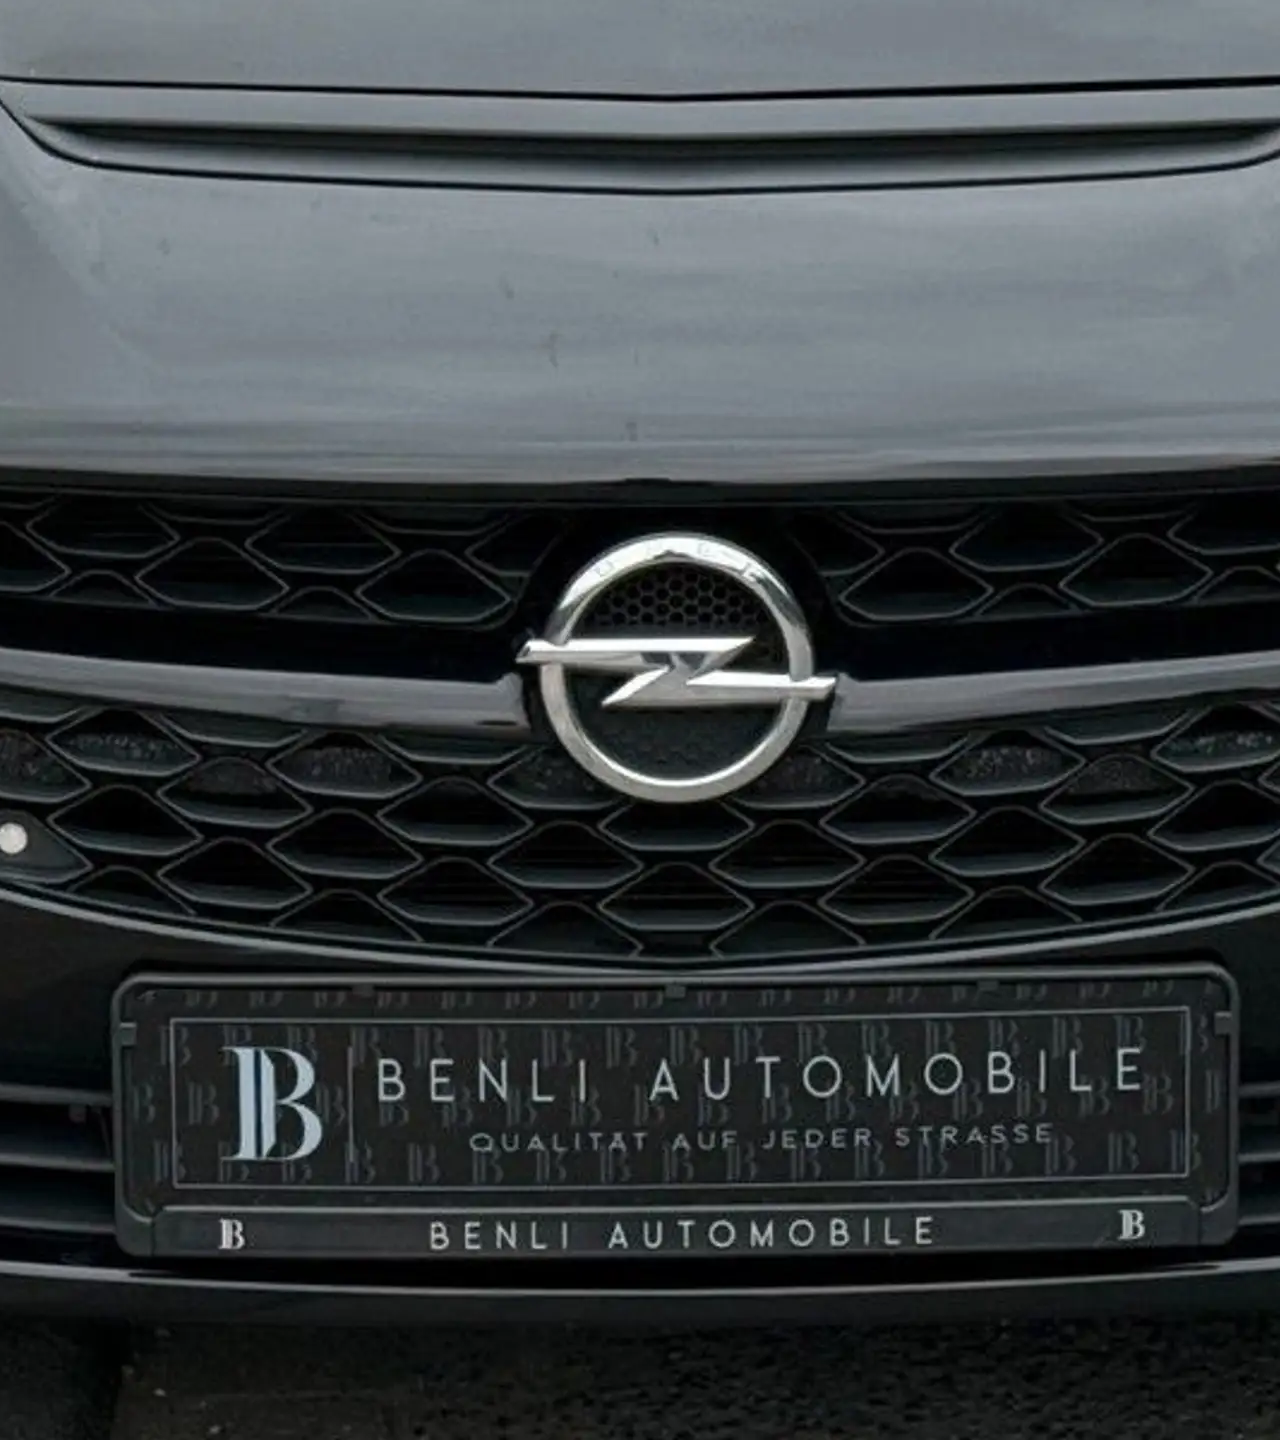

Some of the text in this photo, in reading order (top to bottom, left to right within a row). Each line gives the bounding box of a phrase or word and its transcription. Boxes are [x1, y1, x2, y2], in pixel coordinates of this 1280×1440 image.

[377, 1046, 1144, 1103] BENLI AUTOMOBILE
[671, 1130, 737, 1152] AUF
[762, 1127, 873, 1150] JEDER
[894, 1123, 1054, 1148] STRASSE
[428, 1215, 935, 1251] BENLI AUTOMOBILE
